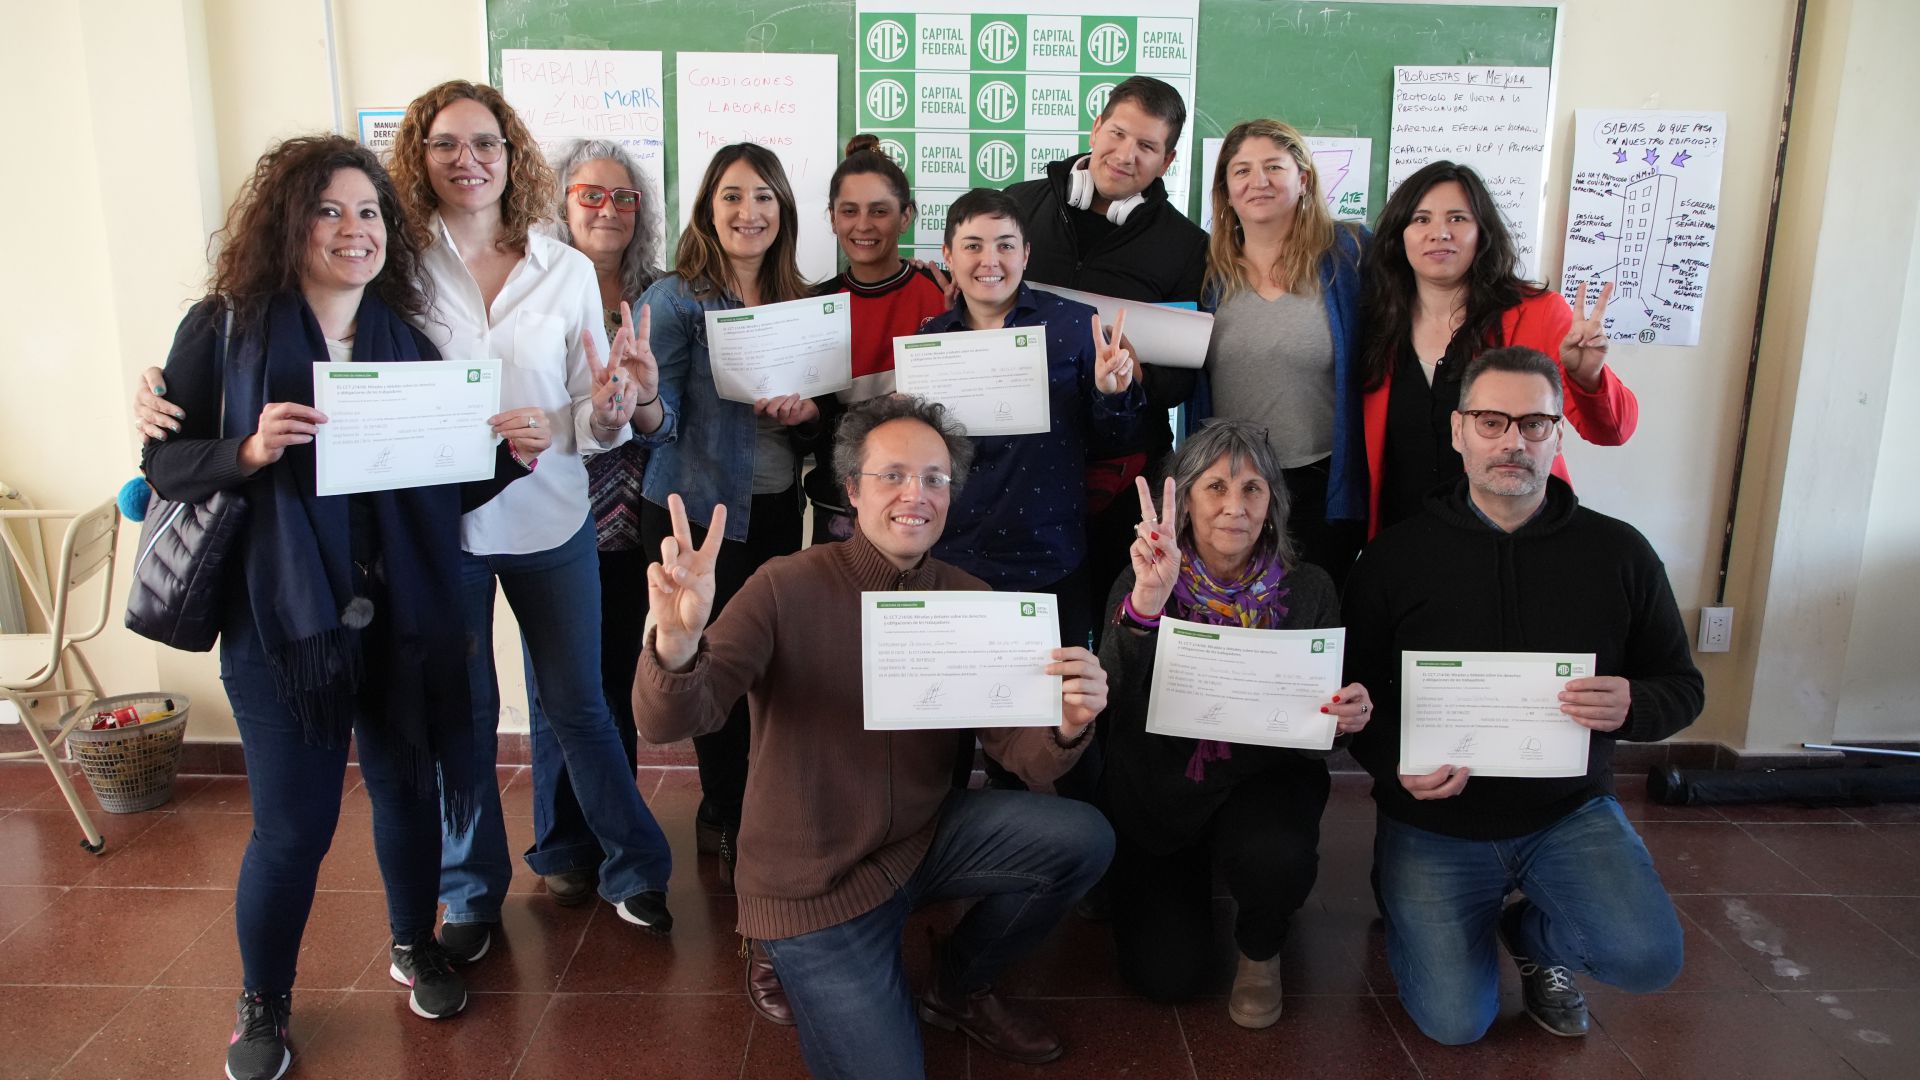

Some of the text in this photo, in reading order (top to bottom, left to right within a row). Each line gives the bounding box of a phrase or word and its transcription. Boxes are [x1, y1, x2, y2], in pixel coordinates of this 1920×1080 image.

[922, 27, 963, 41] CAPITAL
[1033, 29, 1074, 43] CAPITAL
[1143, 31, 1184, 45] CAPITAL
[869, 23, 906, 60] ATE
[980, 23, 1018, 61] ATE
[1090, 25, 1127, 63] ATE
[922, 42, 967, 56] FEDERAL
[1033, 44, 1078, 57] FEDERAL
[1143, 46, 1187, 60] FEDERAL
[508, 58, 618, 87] TRABAJAR
[1399, 69, 1460, 83] PROPUESTAS
[552, 88, 660, 110] Y NO MORIR
[869, 81, 906, 119] ATE
[921, 87, 962, 100] CAPITAL
[1032, 89, 1073, 102] CAPITAL
[709, 100, 796, 114] LABORALES
[921, 102, 966, 115] FEDERAL
[979, 83, 1016, 121] ATE
[1031, 104, 1076, 117] FEDERAL
[374, 122, 401, 130] MANUAL
[544, 112, 577, 126] EL
[582, 112, 660, 132] INTENTO
[1601, 122, 1646, 135] SABIAS
[1670, 123, 1690, 135] QUE
[1693, 123, 1712, 133] PASA
[373, 130, 396, 138] DEREC
[1456, 145, 1471, 153] EN
[1476, 142, 1493, 153] RCP
[1606, 137, 1617, 145] EN
[1622, 137, 1664, 146] NUESTRO
[921, 146, 962, 159] CAPITAL
[921, 161, 966, 173] FEDERAL
[979, 142, 1015, 179] ATE
[1339, 191, 1364, 204] ATE
[921, 204, 949, 216] CAPIT
[921, 219, 946, 230] FEDE
[1672, 301, 1694, 312] RATAS
[1651, 314, 1671, 324] PISOS
[1650, 322, 1670, 331] ROTOS
